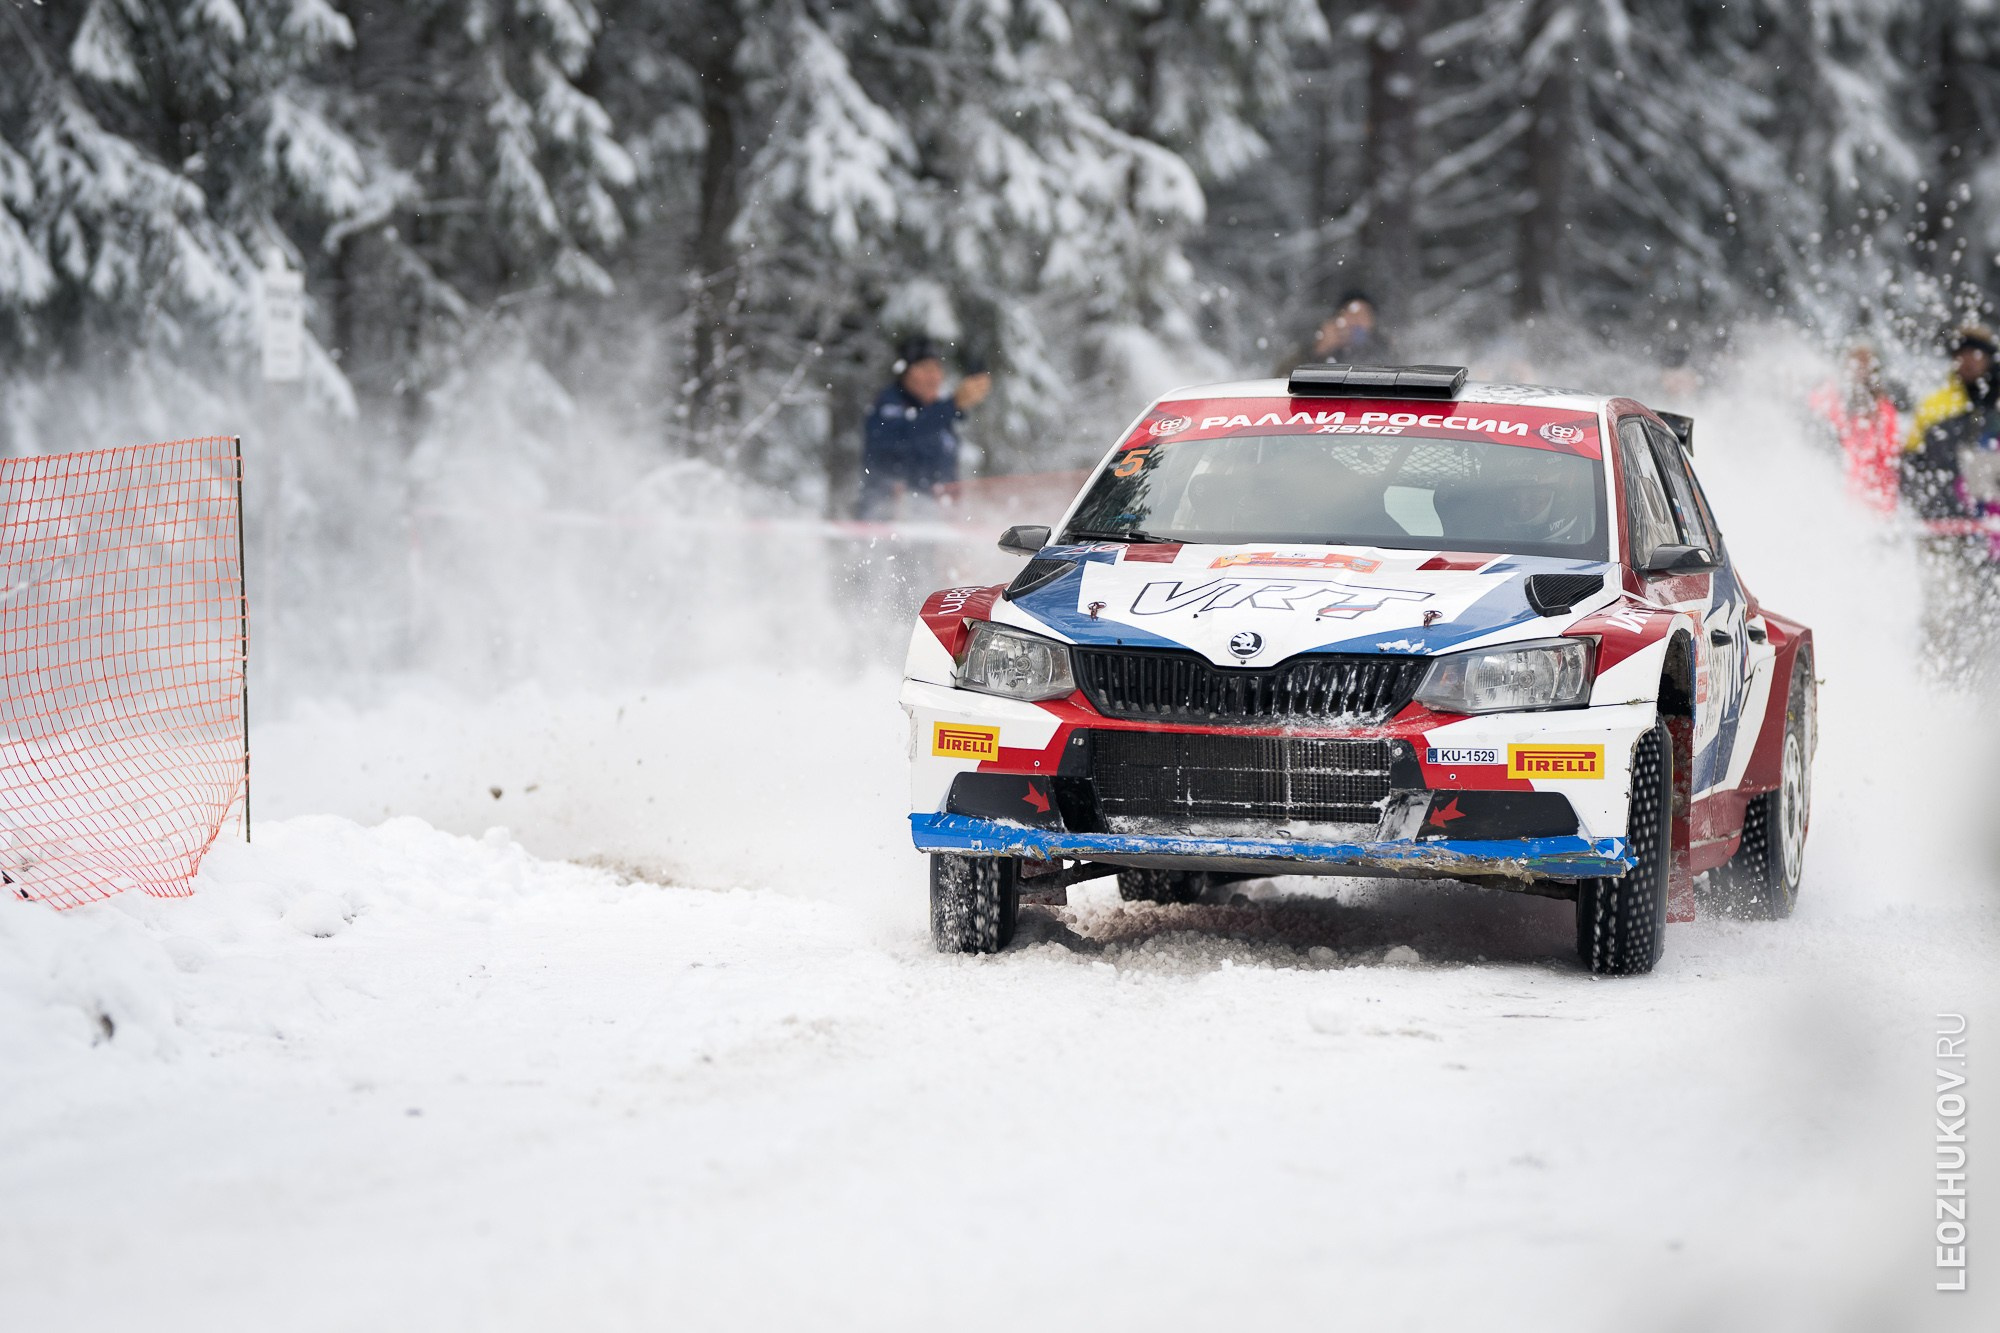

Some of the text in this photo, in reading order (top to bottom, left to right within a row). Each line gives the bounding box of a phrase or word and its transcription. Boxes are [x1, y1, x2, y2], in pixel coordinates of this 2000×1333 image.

[1200, 412, 1346, 430] РАЛЛИ
[1360, 412, 1528, 436] РОССИИ
[1114, 448, 1151, 478] 5
[1130, 577, 1435, 620] VRT
[937, 728, 993, 755] PIRELLI
[1441, 750, 1495, 762] KU-1529
[1515, 751, 1597, 772] PIRELLI
